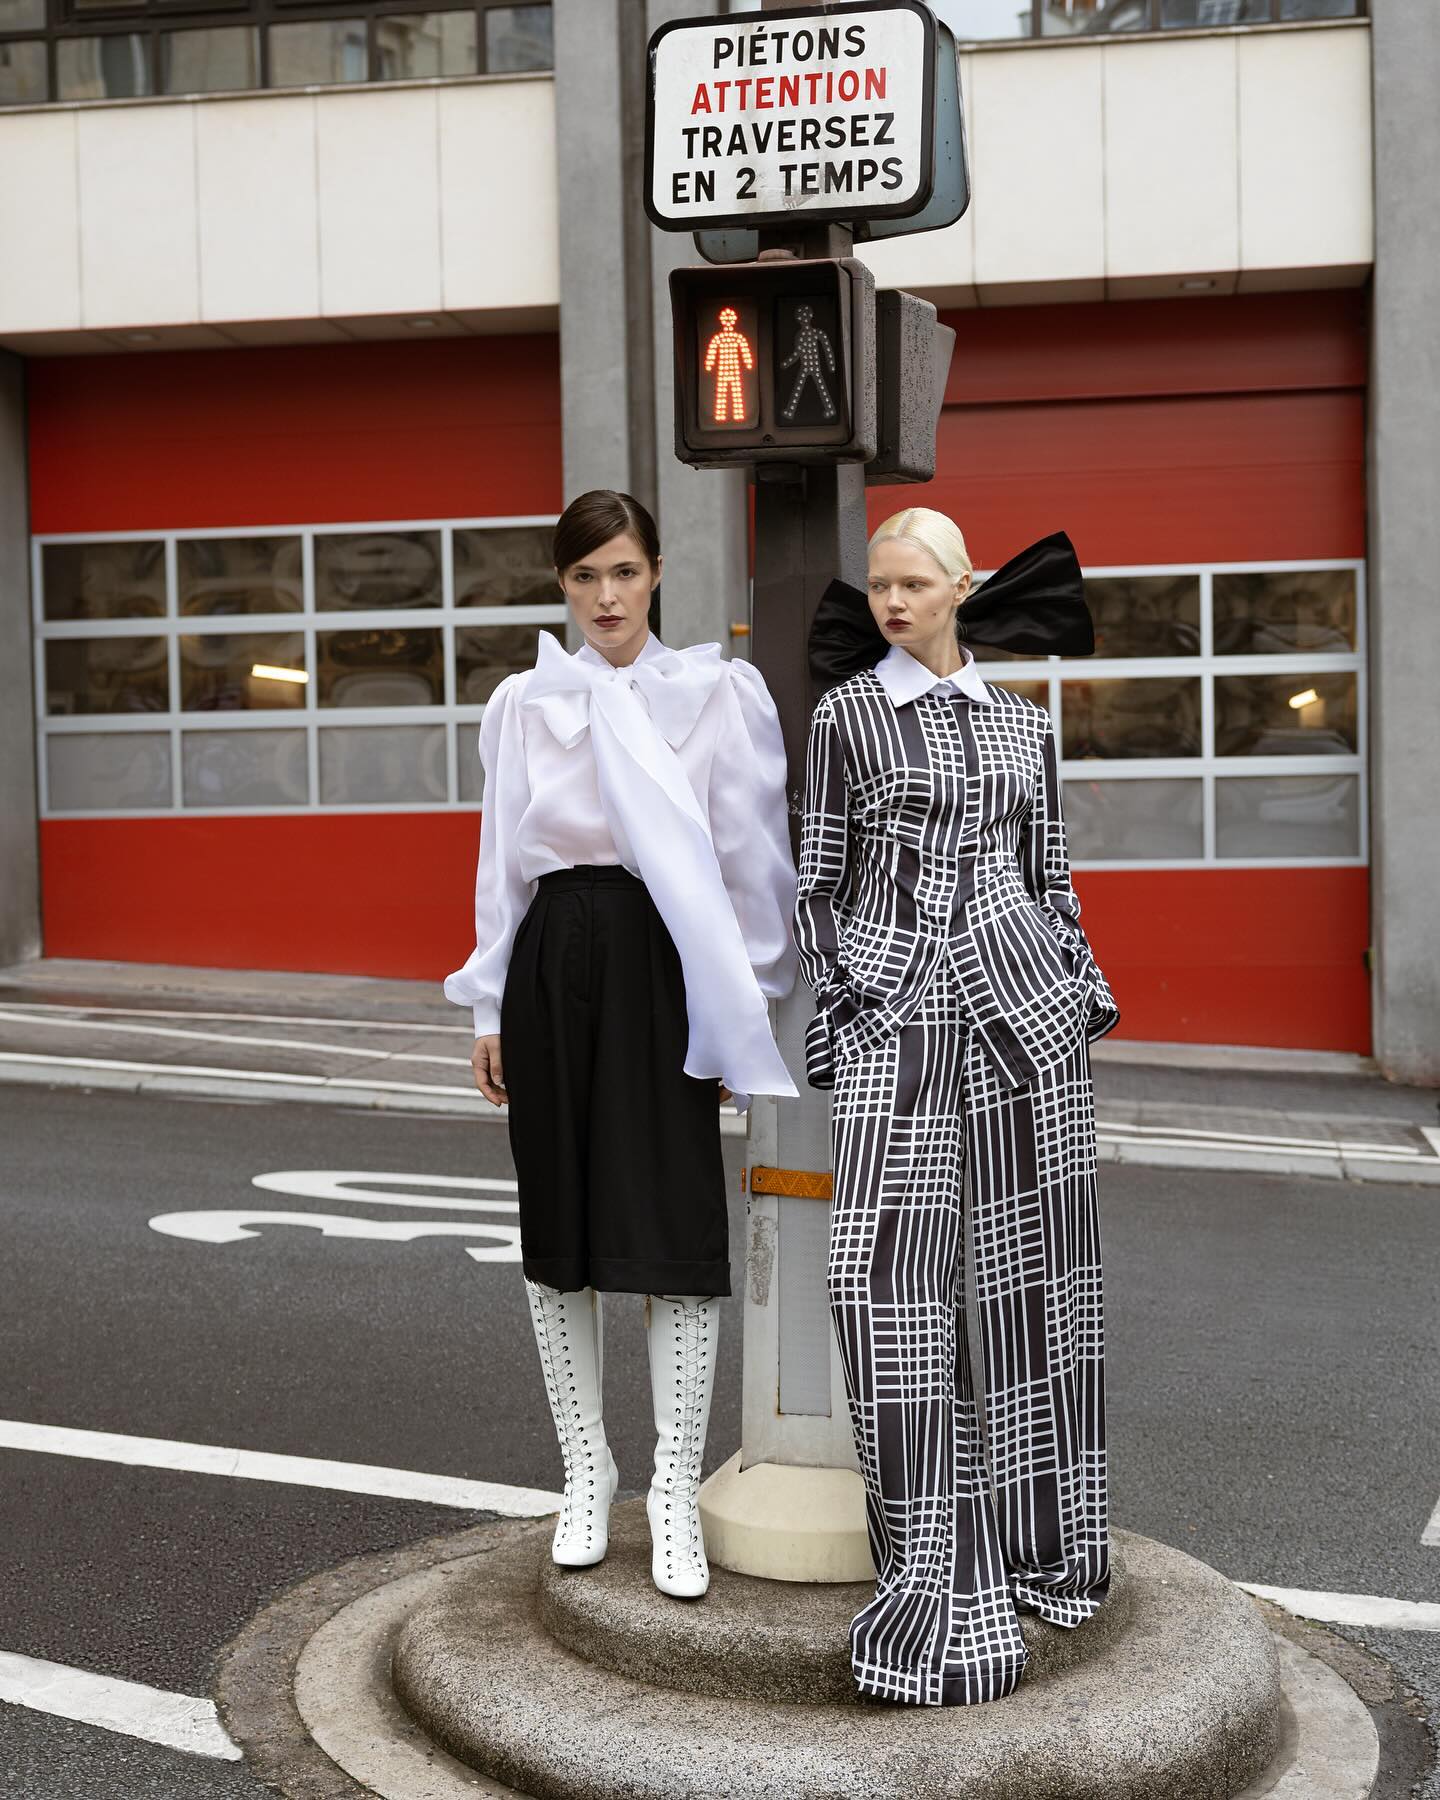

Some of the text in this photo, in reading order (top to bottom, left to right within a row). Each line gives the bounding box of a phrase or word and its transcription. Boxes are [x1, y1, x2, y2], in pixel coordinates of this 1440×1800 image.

[713, 25, 866, 69] PIÉTONS
[690, 67, 886, 115] ATTENTION
[681, 112, 895, 160] TRAVERSEZ
[672, 157, 903, 205] EN 2 TEMPS
